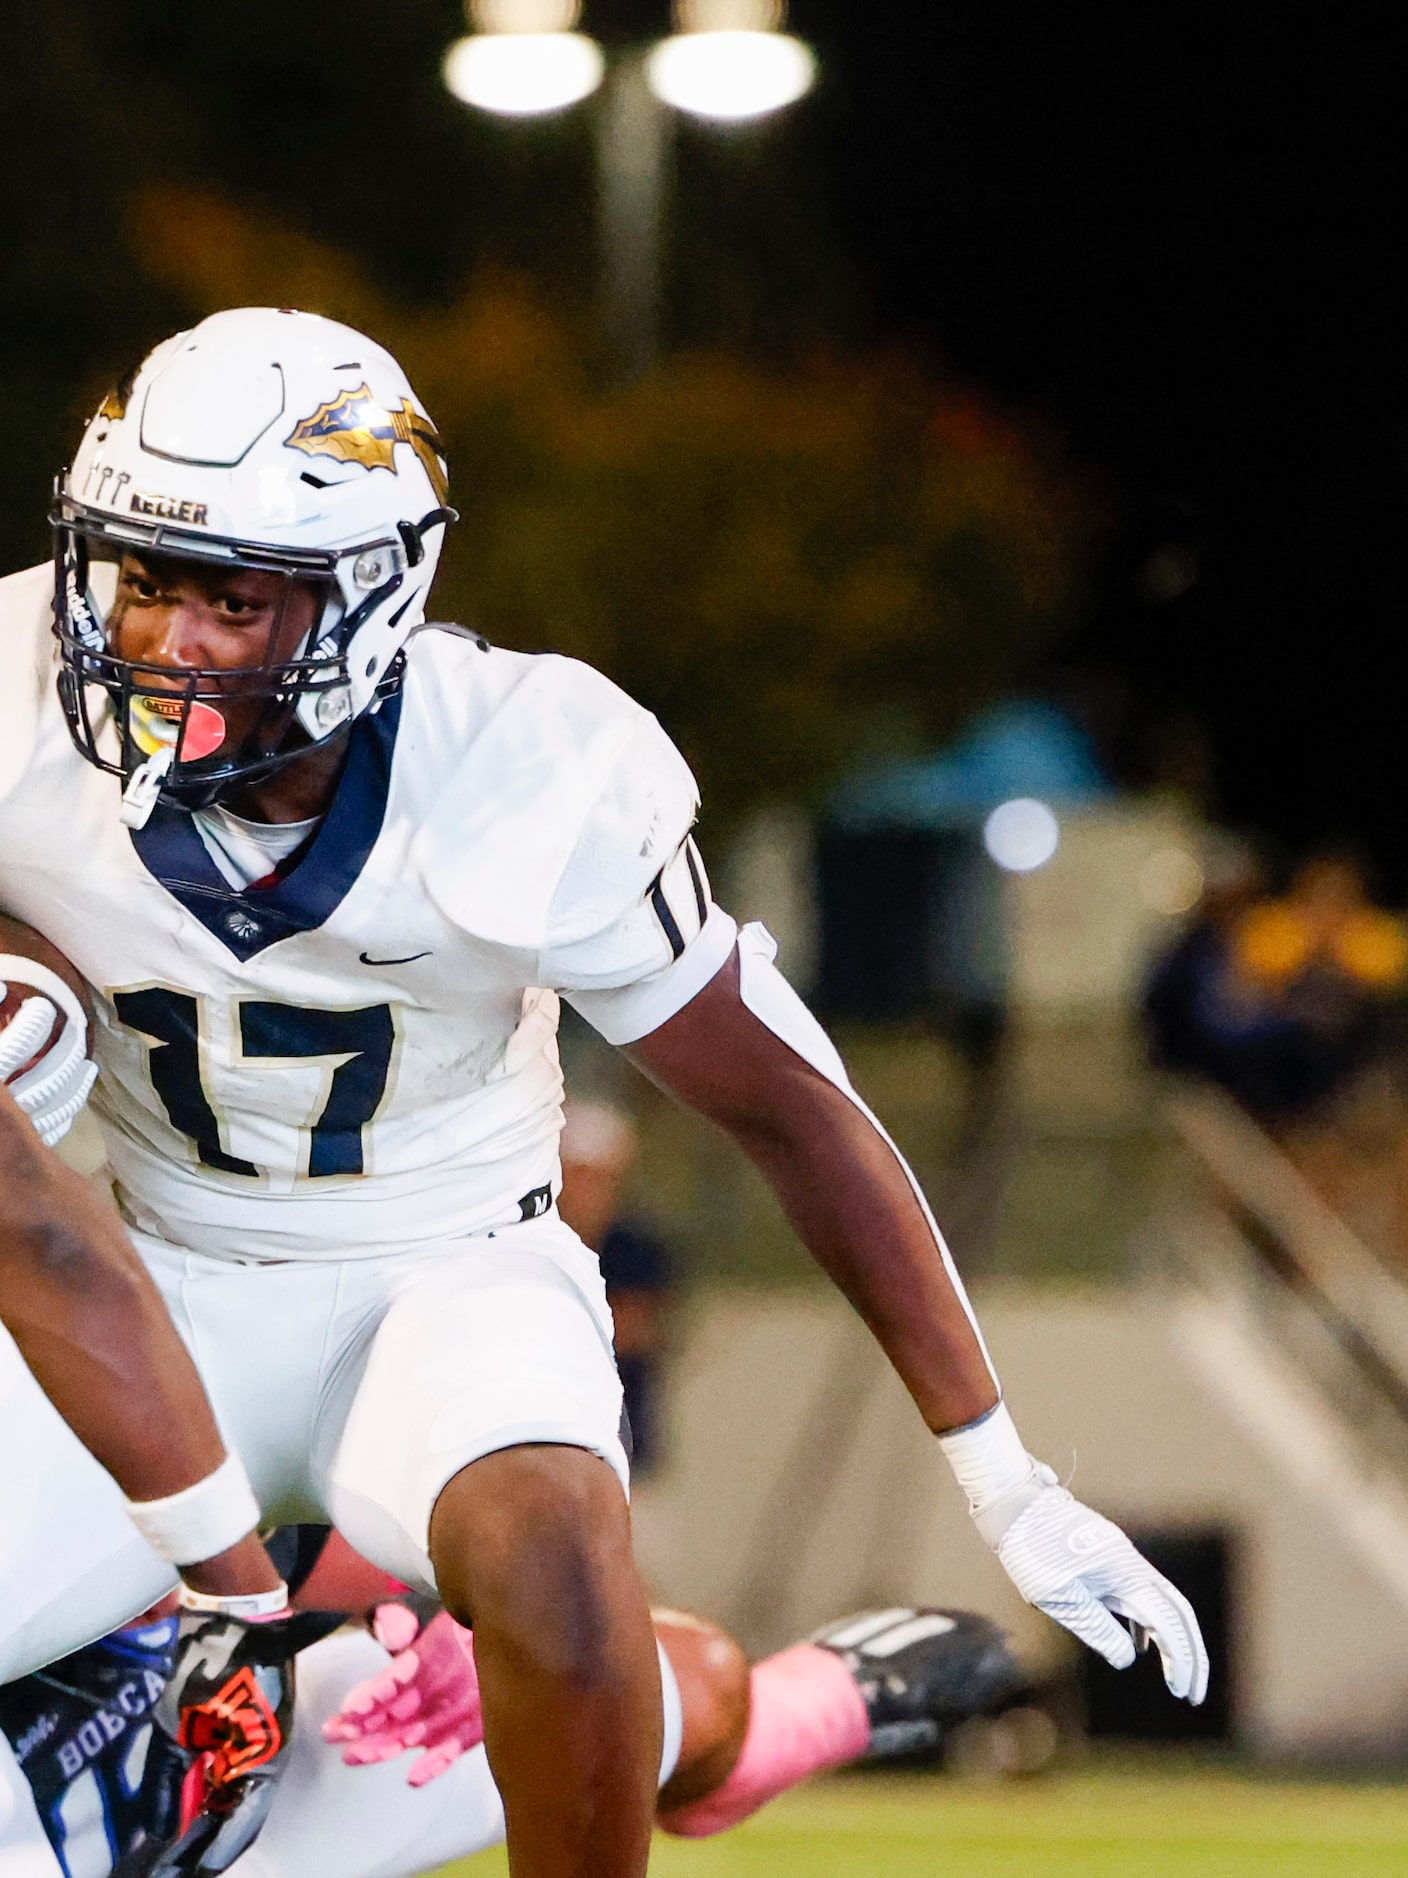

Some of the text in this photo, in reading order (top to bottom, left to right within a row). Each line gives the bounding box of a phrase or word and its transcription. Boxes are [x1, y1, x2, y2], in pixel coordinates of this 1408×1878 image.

[130, 489, 208, 526] KELLER
[106, 981, 402, 1184] 17
[56, 1664, 168, 1779] BOBCA
